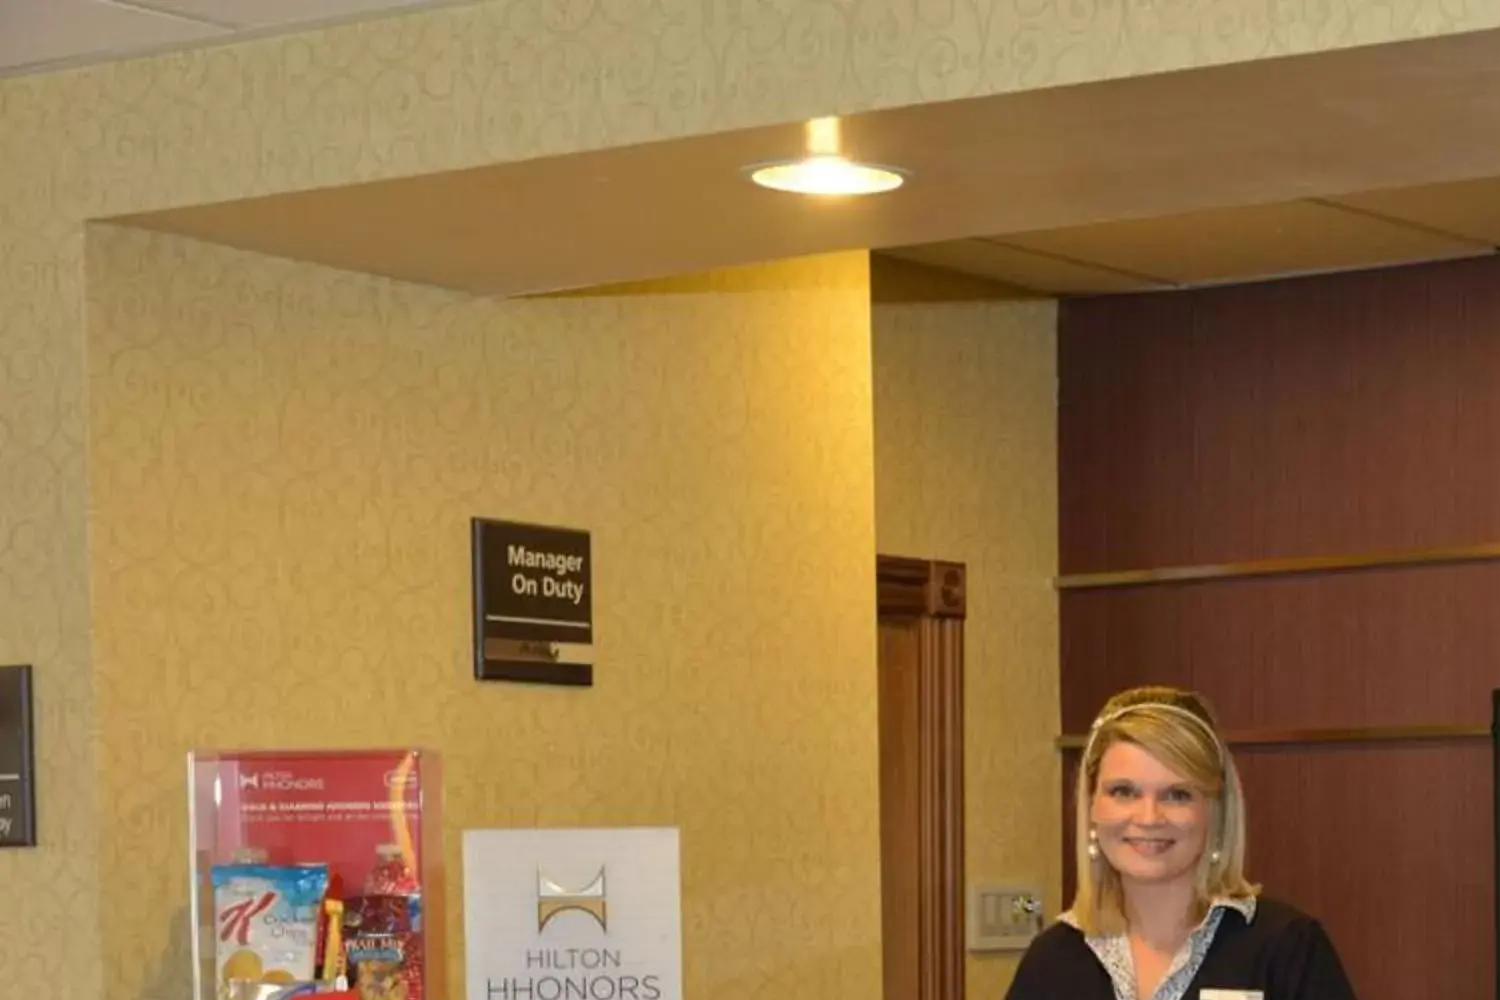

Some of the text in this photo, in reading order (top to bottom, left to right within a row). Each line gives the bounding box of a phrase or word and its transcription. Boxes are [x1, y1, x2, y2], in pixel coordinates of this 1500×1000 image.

[507, 545, 583, 575] Manager
[512, 573, 583, 605] On Duty
[526, 949, 622, 970] HILTON
